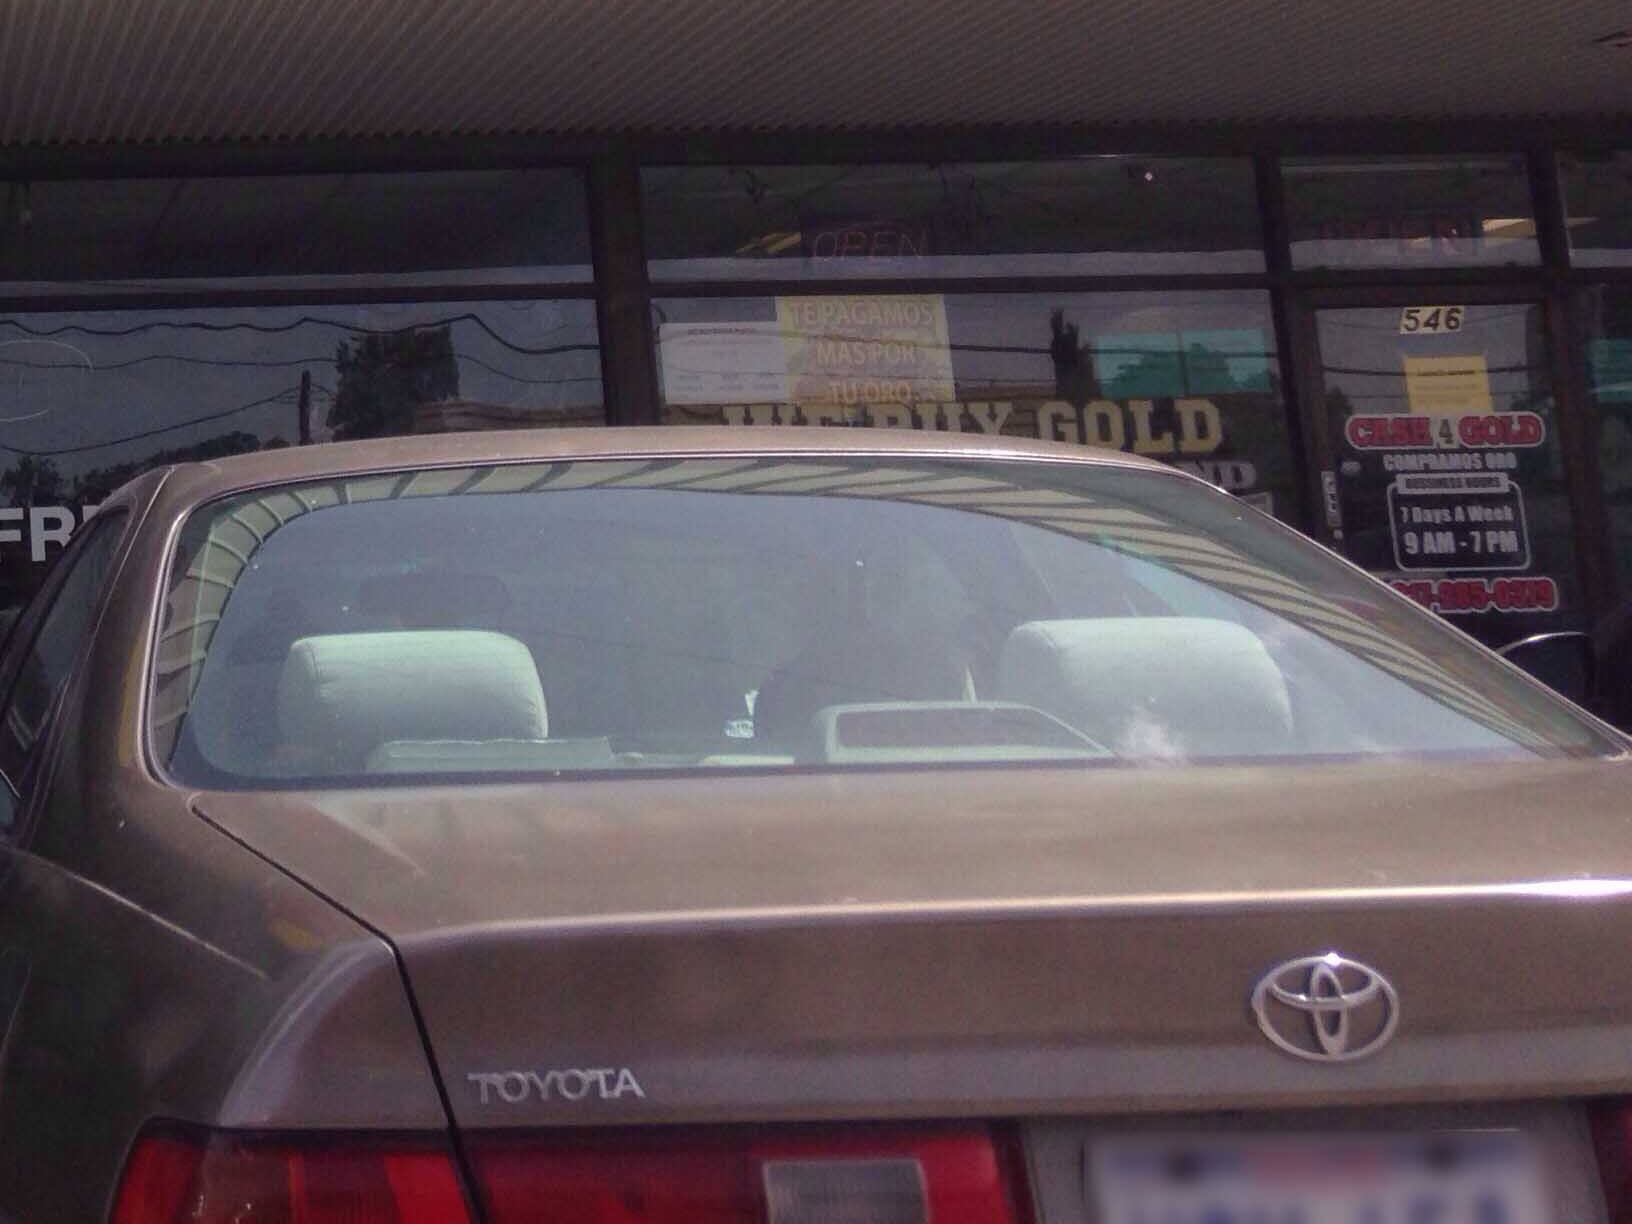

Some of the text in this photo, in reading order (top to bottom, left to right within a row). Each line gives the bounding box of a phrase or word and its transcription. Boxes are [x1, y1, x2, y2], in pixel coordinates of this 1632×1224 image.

[1402, 307, 1462, 332] 546
[1036, 398, 1223, 454] GOLD
[1437, 418, 1454, 444] 4
[1457, 415, 1542, 446] GOLD
[1412, 507, 1452, 524] Days
[1454, 505, 1465, 522] A
[1467, 504, 1514, 522] Week
[1403, 531, 1419, 554] 9
[1423, 531, 1457, 554] AM
[1470, 531, 1481, 553] 7
[1485, 530, 1519, 553] PM
[467, 1067, 647, 1104] TOYOTA
